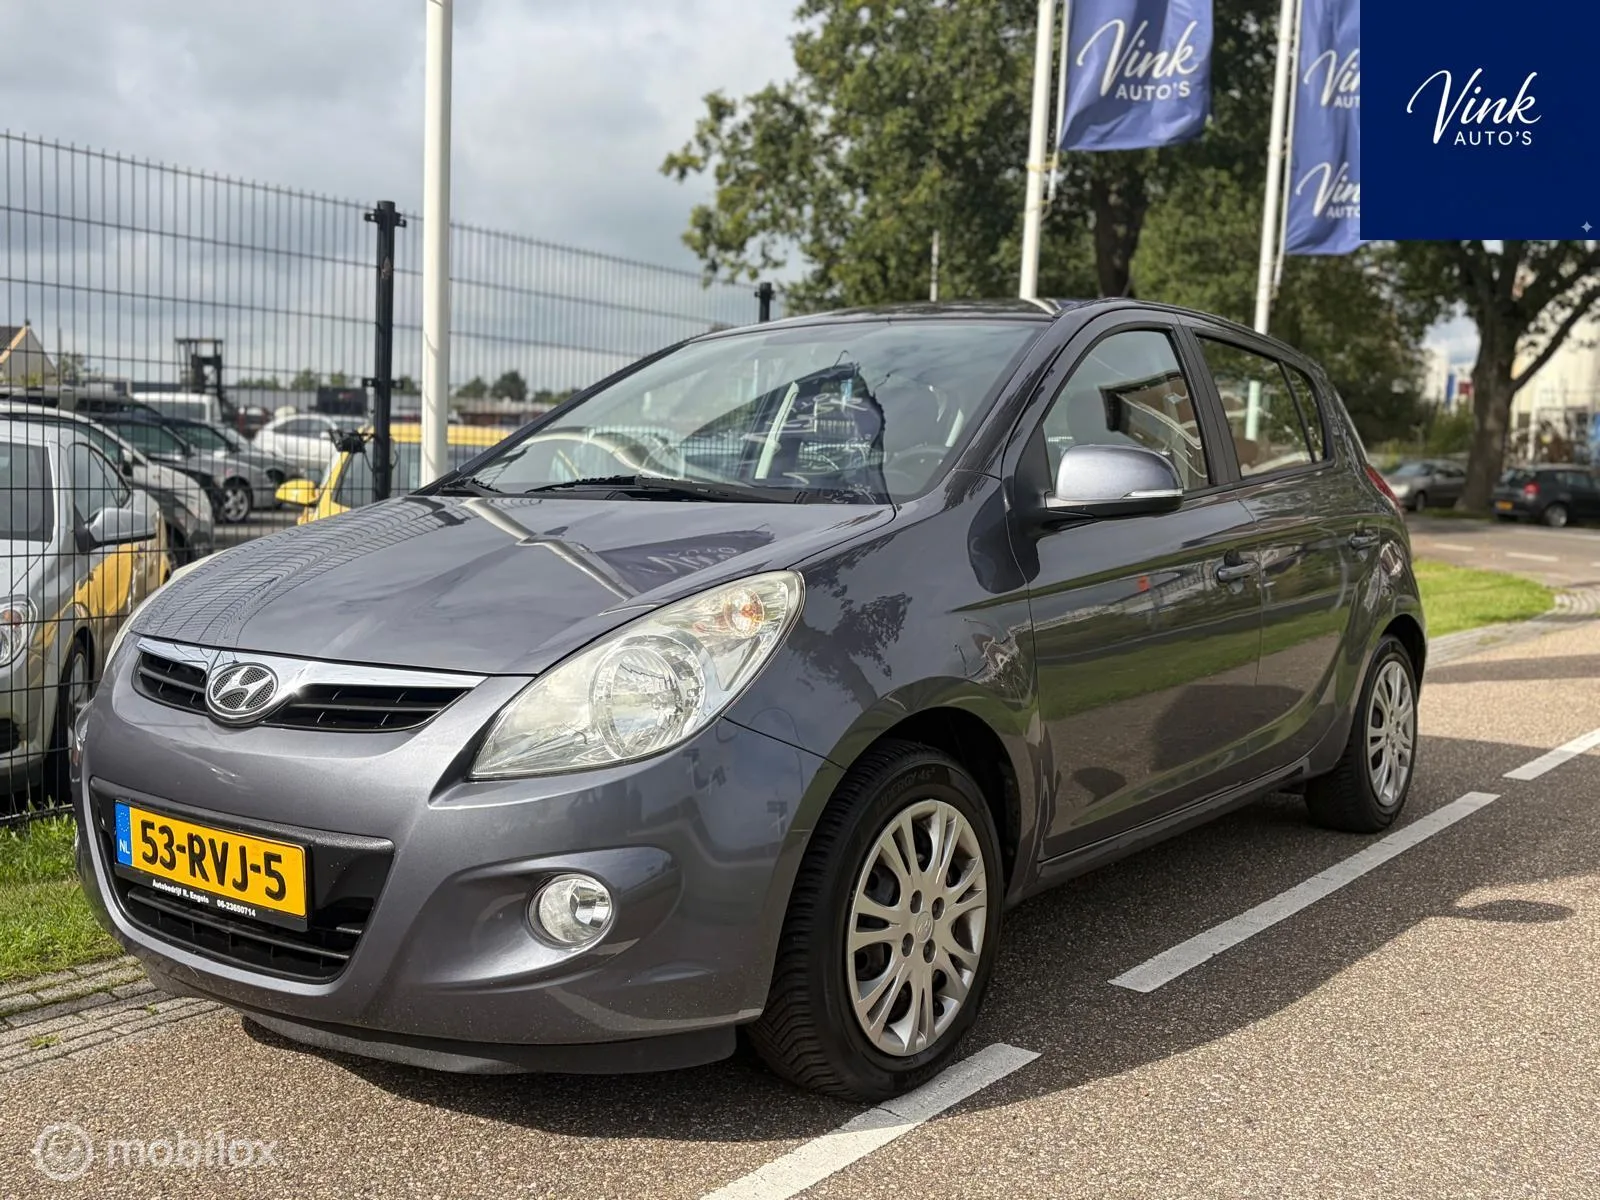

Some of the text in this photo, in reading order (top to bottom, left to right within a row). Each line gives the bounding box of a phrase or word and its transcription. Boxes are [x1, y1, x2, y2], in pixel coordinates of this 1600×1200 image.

[1076, 19, 1199, 96] Vink
[1115, 81, 1190, 100] AUTO'S
[119, 839, 131, 855] NL
[140, 819, 287, 902] 53-RVJ-5
